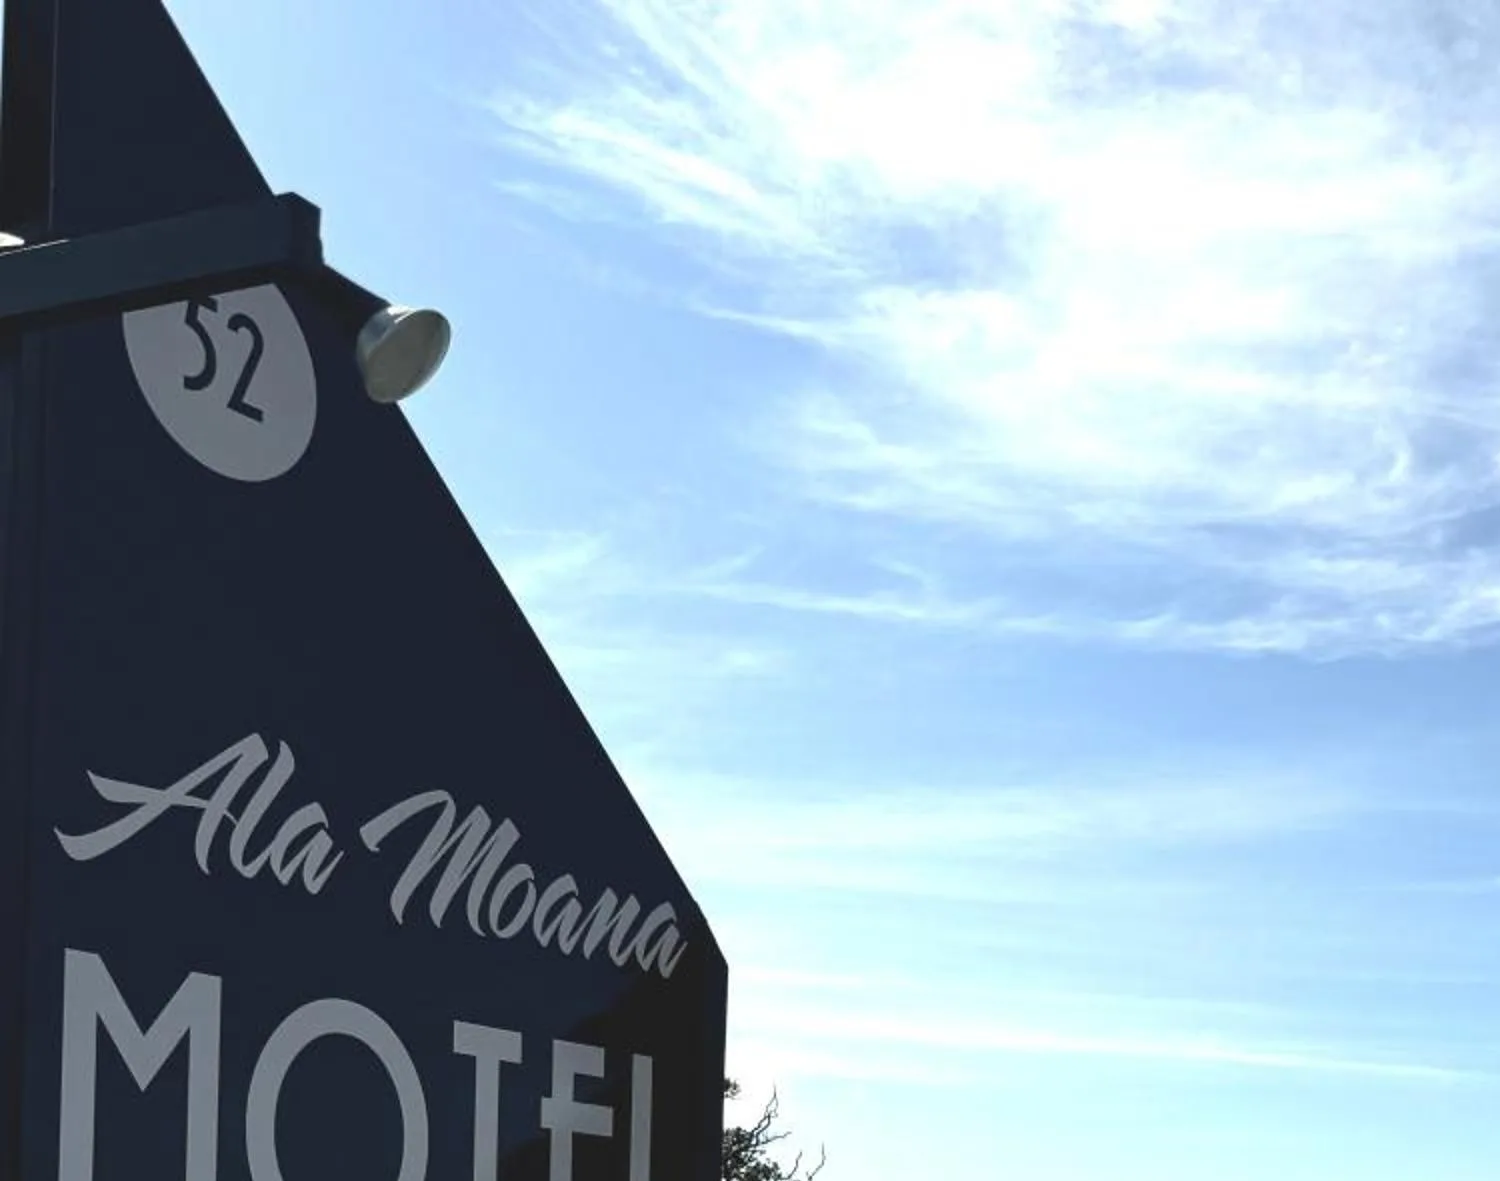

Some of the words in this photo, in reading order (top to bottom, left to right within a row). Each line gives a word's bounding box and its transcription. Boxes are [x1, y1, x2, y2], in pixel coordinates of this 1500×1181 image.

[183, 296, 264, 424] 52
[53, 732, 345, 896] Ala
[358, 789, 688, 979] Moana
